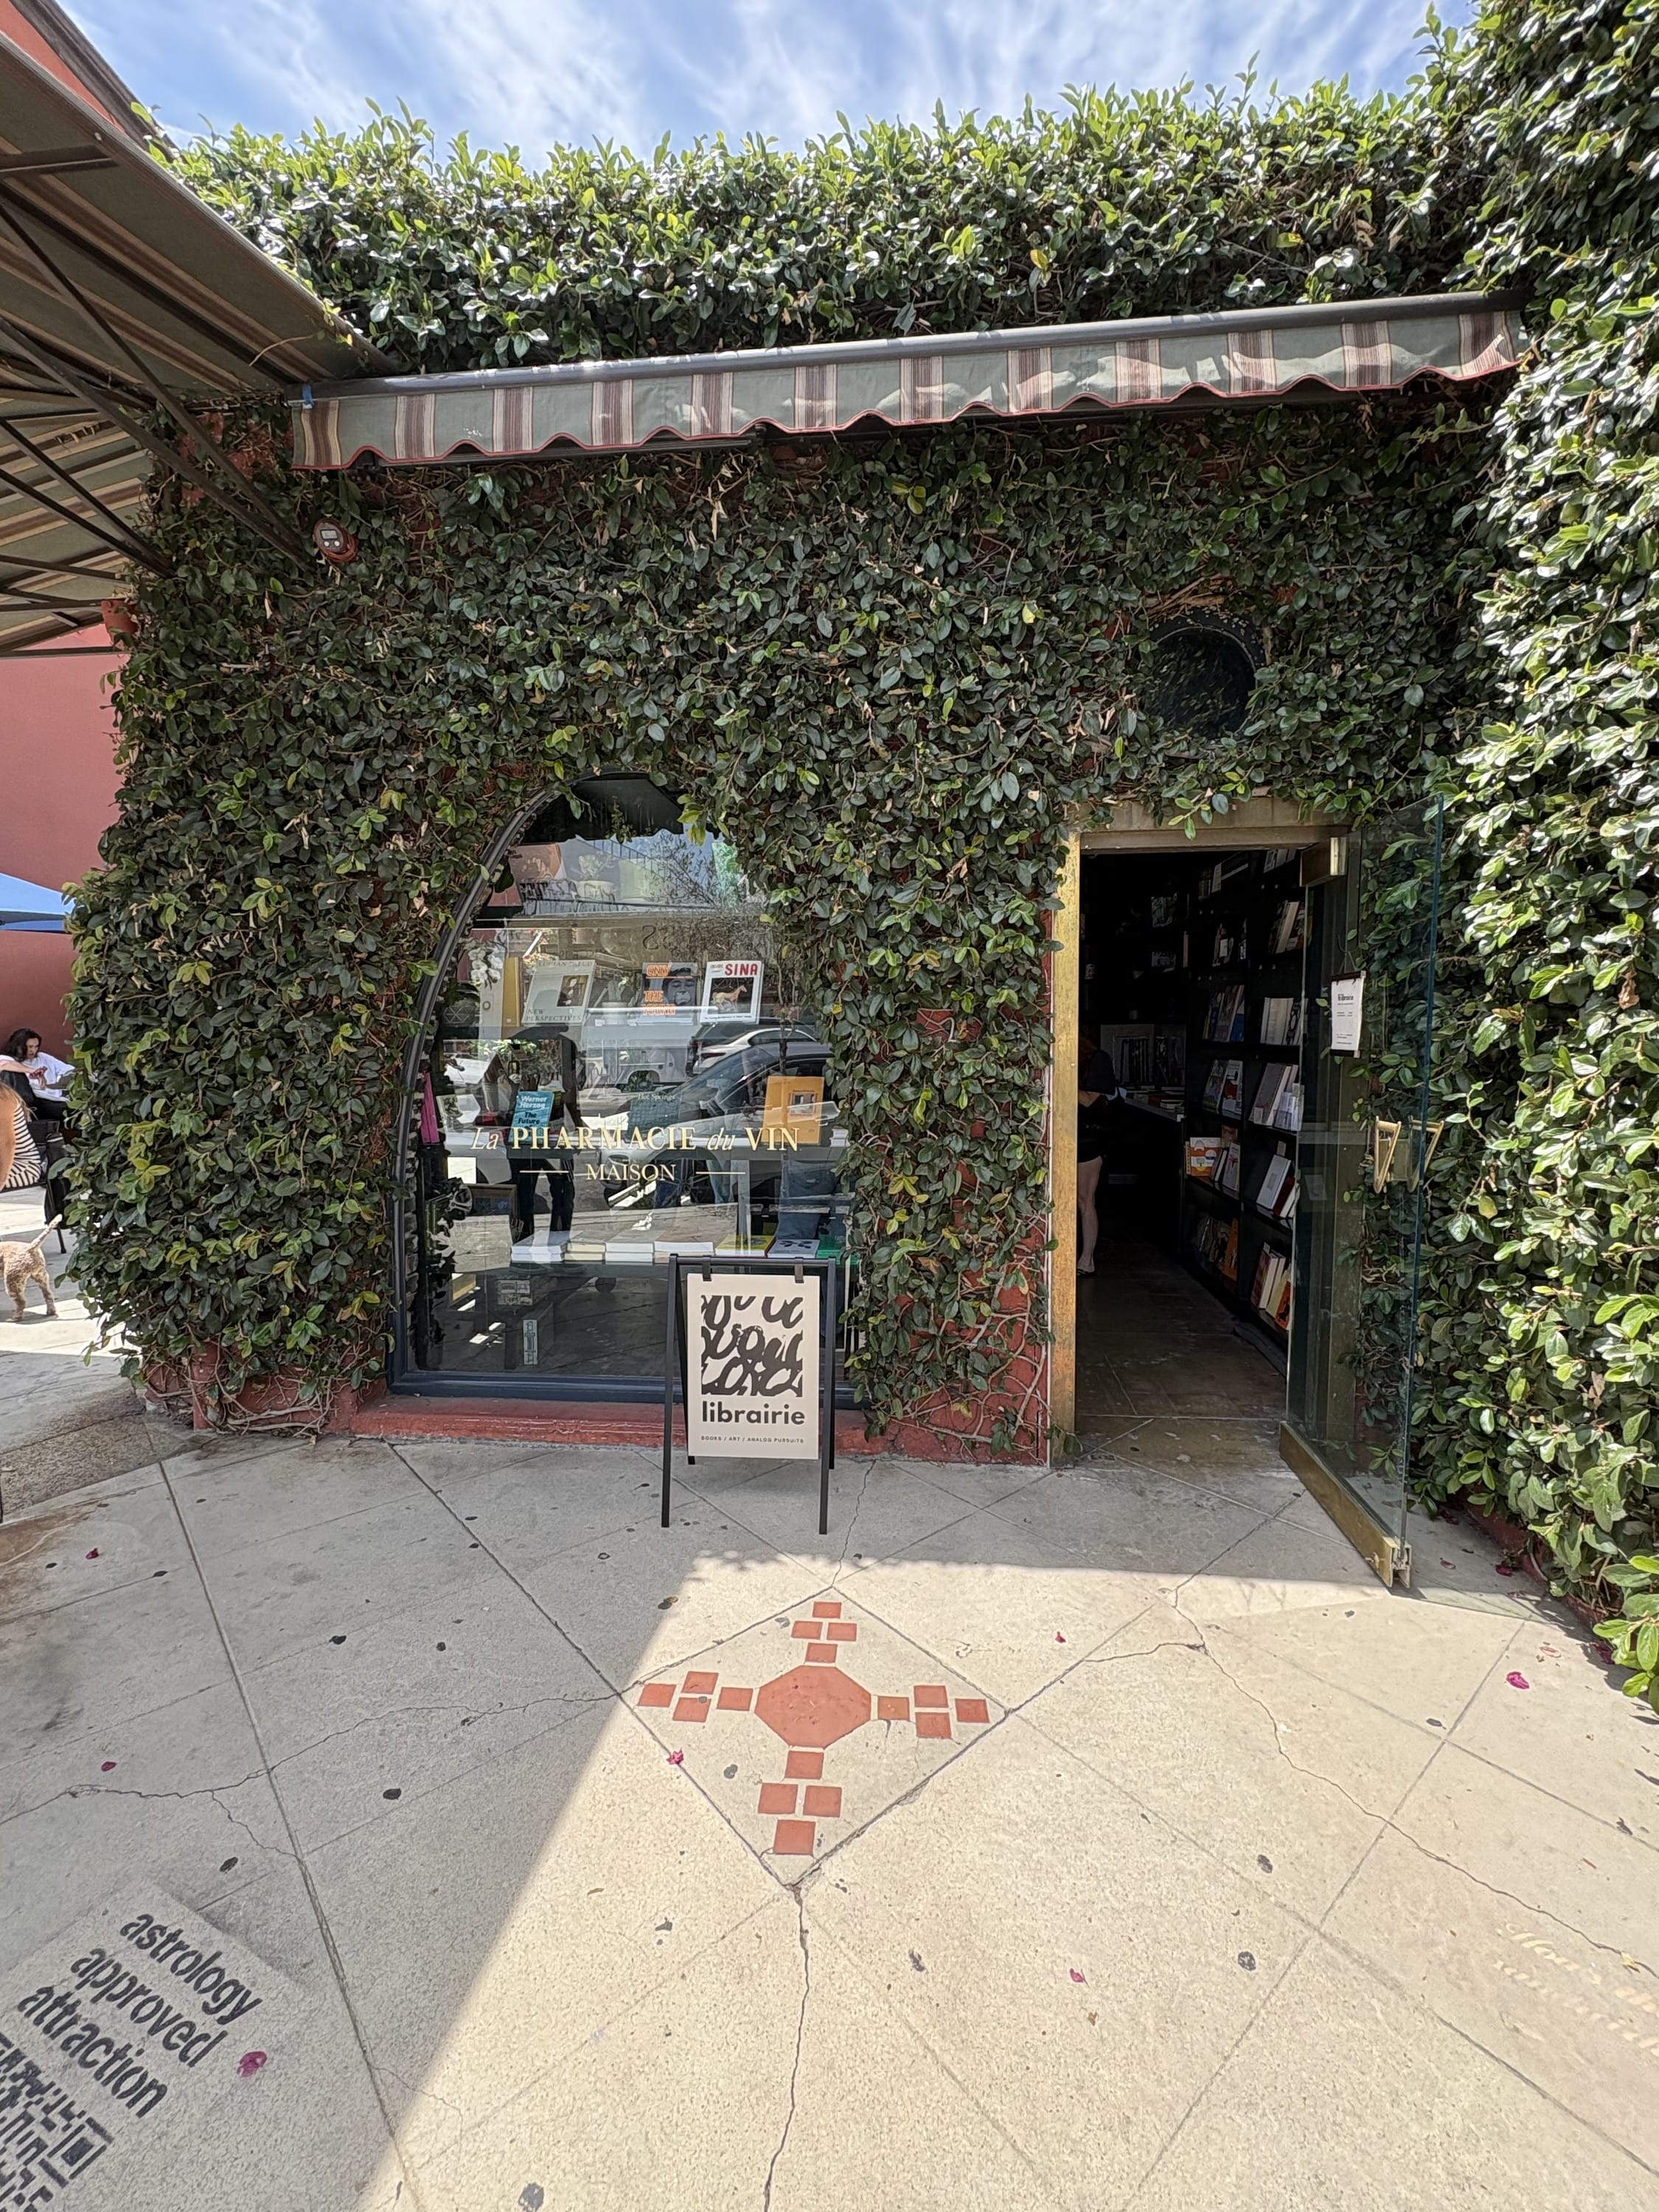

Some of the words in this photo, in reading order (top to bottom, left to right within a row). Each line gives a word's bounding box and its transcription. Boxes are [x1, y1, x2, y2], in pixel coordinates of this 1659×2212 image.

[725, 964, 758, 975] SINA
[644, 991, 664, 1002] THE
[470, 1127, 499, 1150] La
[511, 1126, 696, 1150] PHARMACIE
[706, 1127, 736, 1151] du
[744, 1127, 800, 1152] VIN
[585, 1163, 676, 1181] MAISON
[702, 1400, 806, 1425] librairie
[119, 1913, 263, 2025] astrology
[70, 1948, 229, 2067] approved
[17, 1986, 168, 2118] attraction
